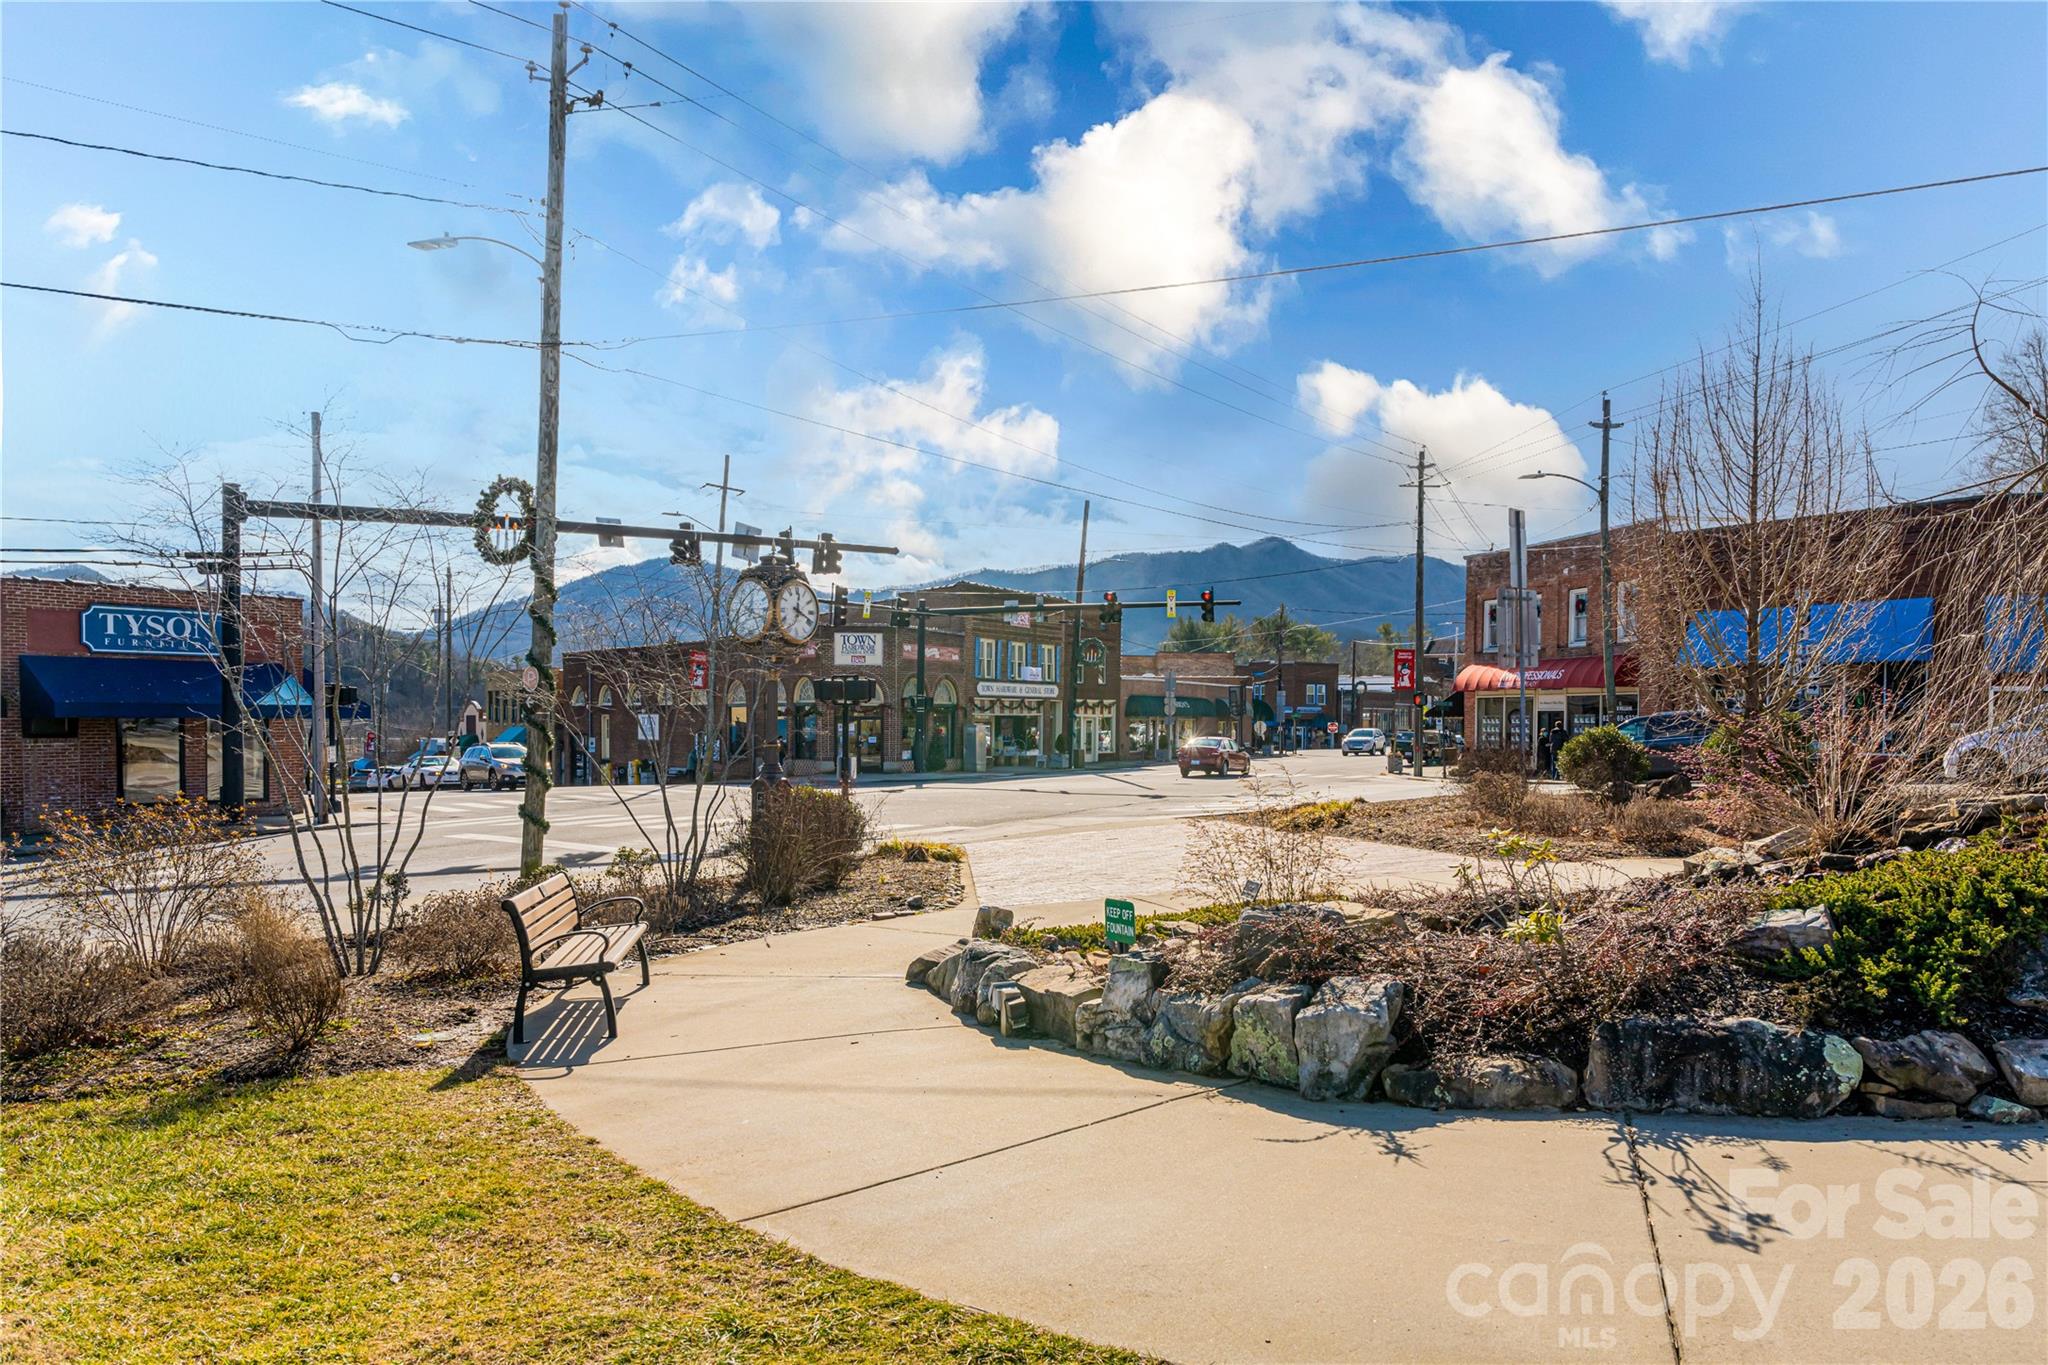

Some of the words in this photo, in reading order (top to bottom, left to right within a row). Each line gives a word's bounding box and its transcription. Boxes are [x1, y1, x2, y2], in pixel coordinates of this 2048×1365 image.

[98, 612, 214, 638] TYSON
[840, 634, 877, 645] TOWN
[1106, 907, 1121, 919] KEEP
[1121, 909, 1133, 921] OFF
[1106, 922, 1134, 937] FOUNTAIN
